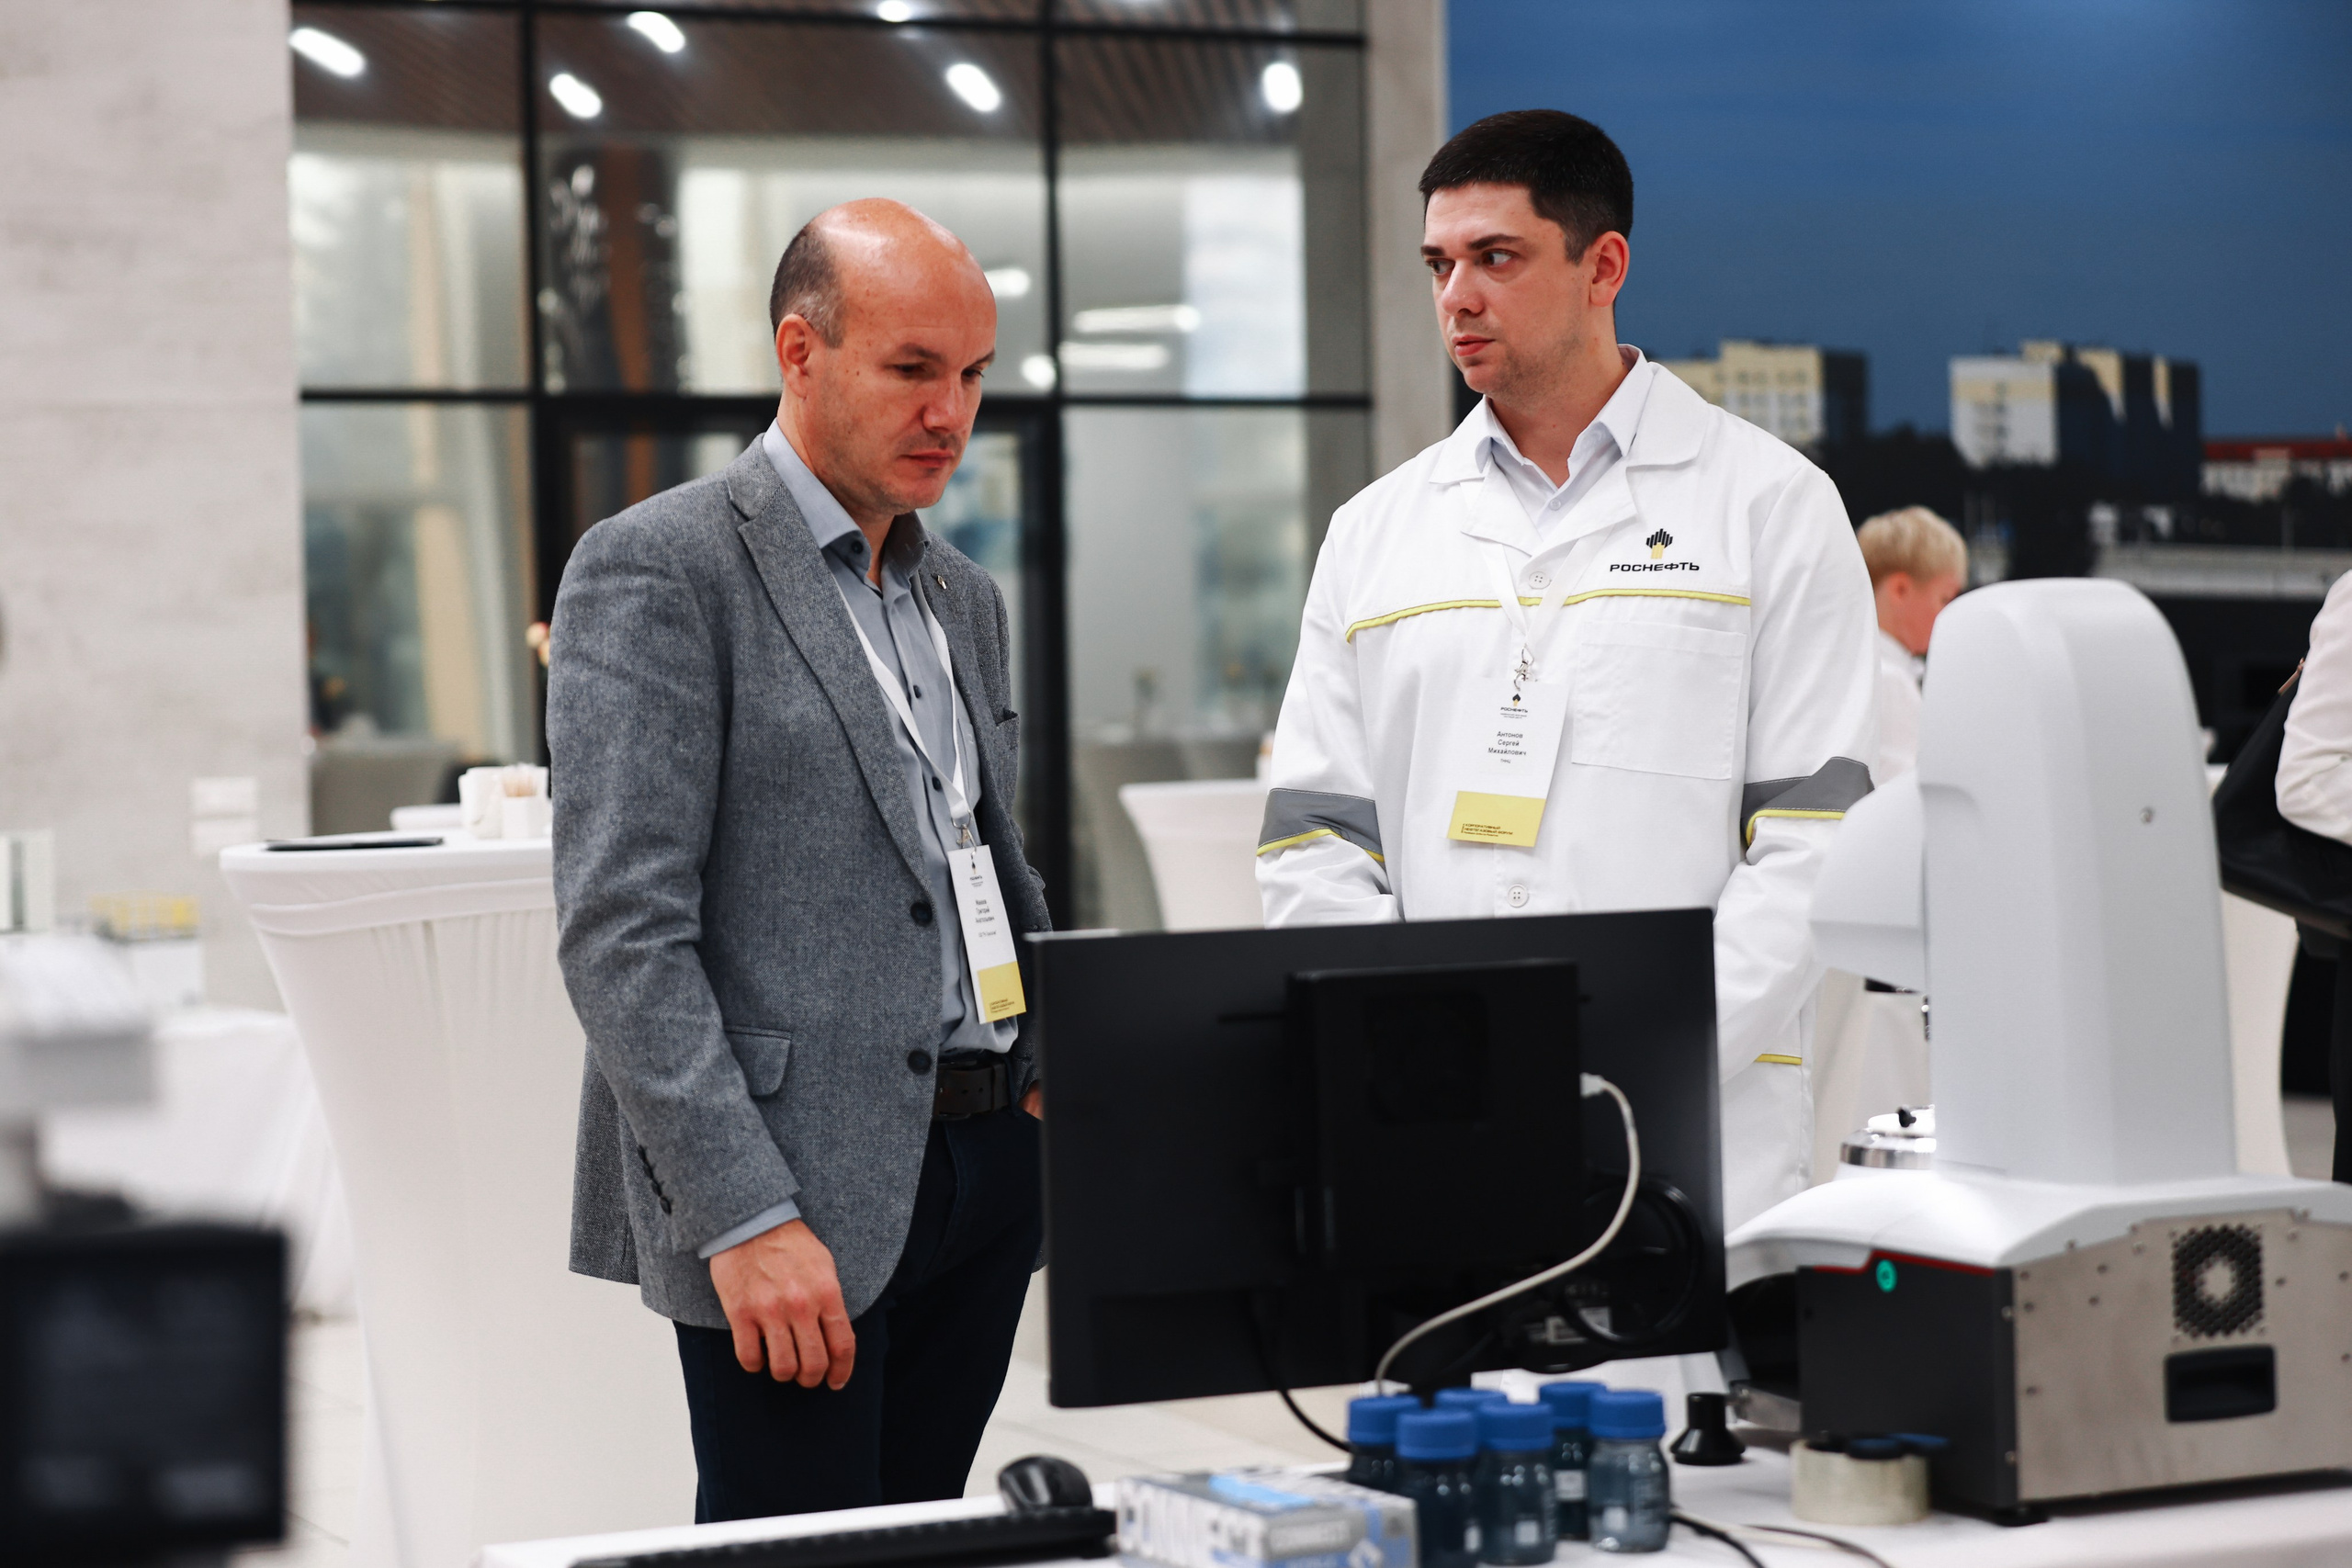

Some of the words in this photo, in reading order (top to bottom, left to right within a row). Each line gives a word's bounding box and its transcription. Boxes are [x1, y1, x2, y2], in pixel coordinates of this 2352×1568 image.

[1610, 562, 1700, 572] РОСНЕФТЬ
[1497, 730, 1523, 739] Антонов
[1498, 739, 1520, 747] Сергей
[1487, 747, 1527, 756] Михайлович
